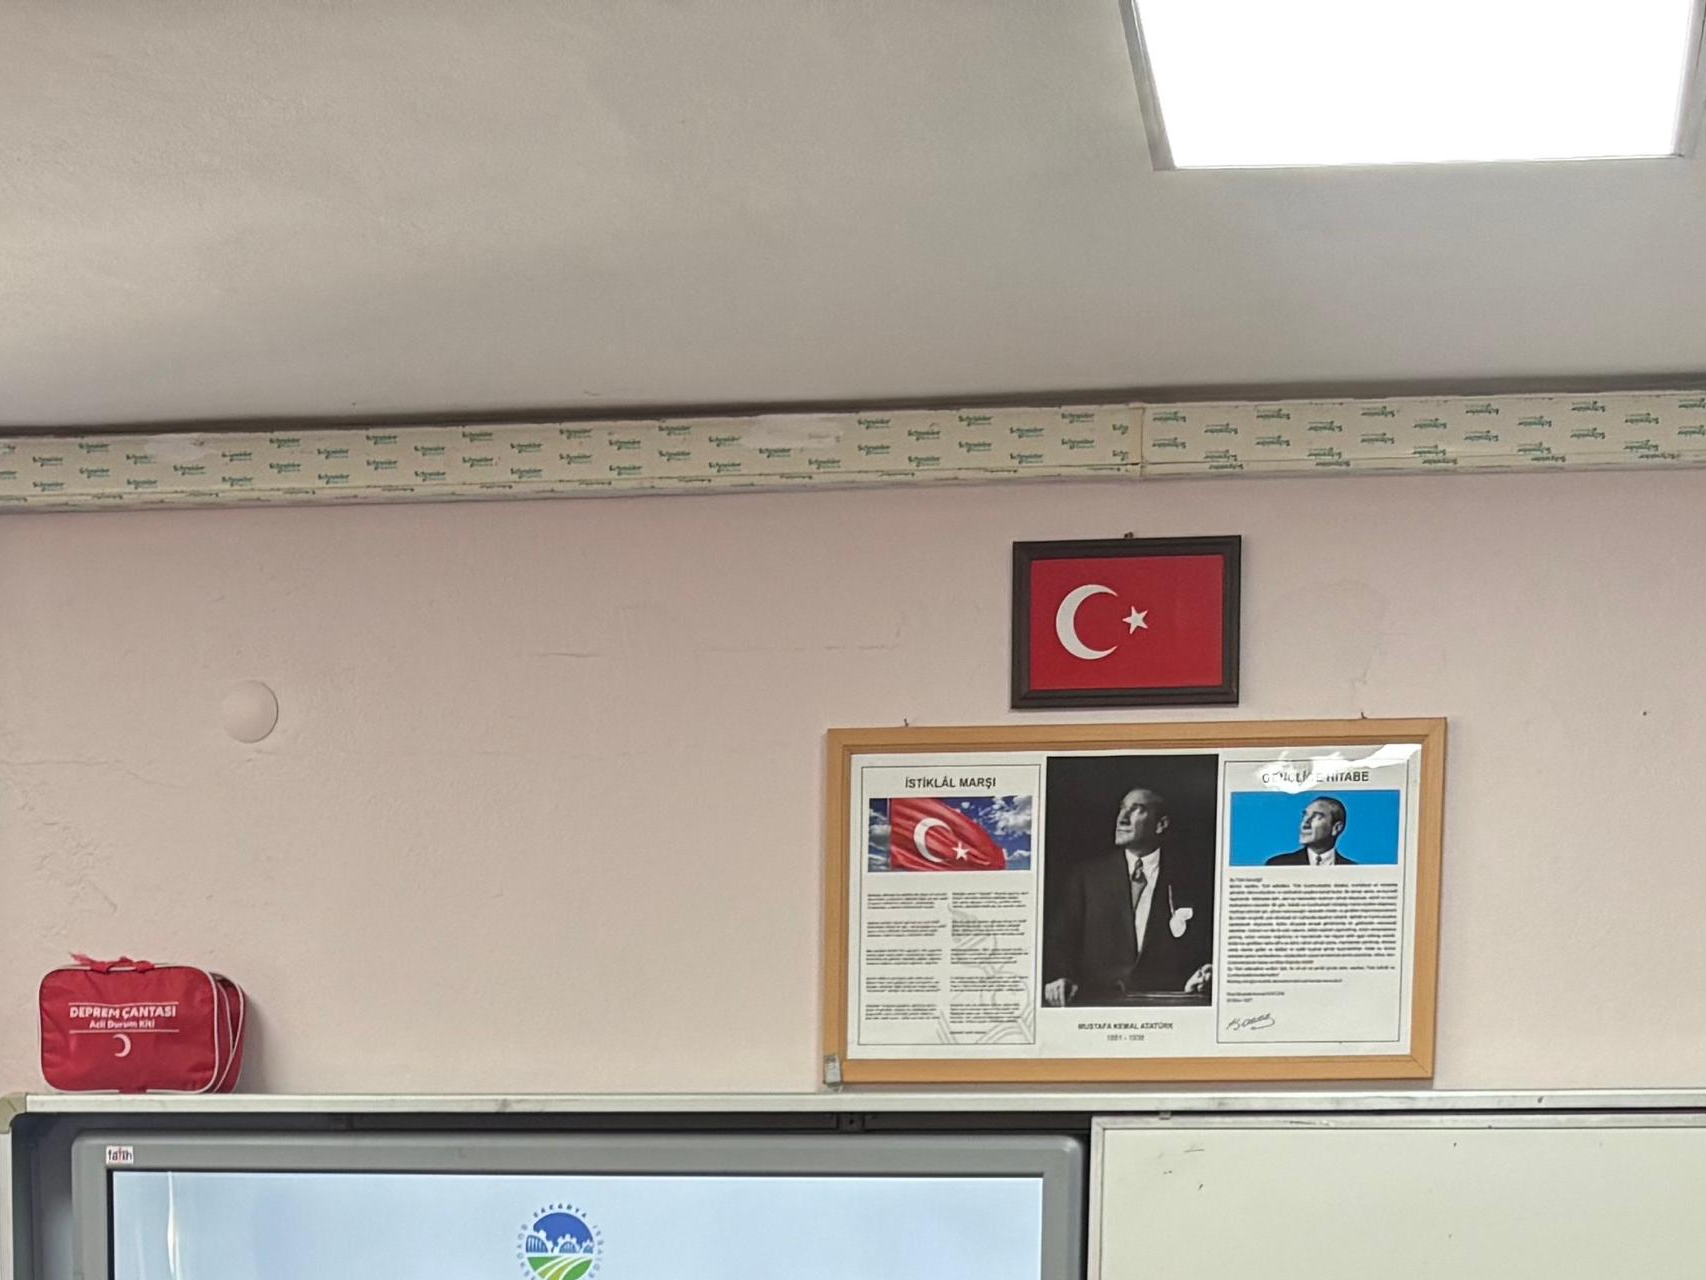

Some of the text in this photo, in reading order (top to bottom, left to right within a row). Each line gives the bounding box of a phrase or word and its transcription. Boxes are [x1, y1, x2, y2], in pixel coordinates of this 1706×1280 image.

[905, 775, 996, 789] İSTİKLÂL MARŞI
[70, 1006, 177, 1019] DEPREM ÇANTASI
